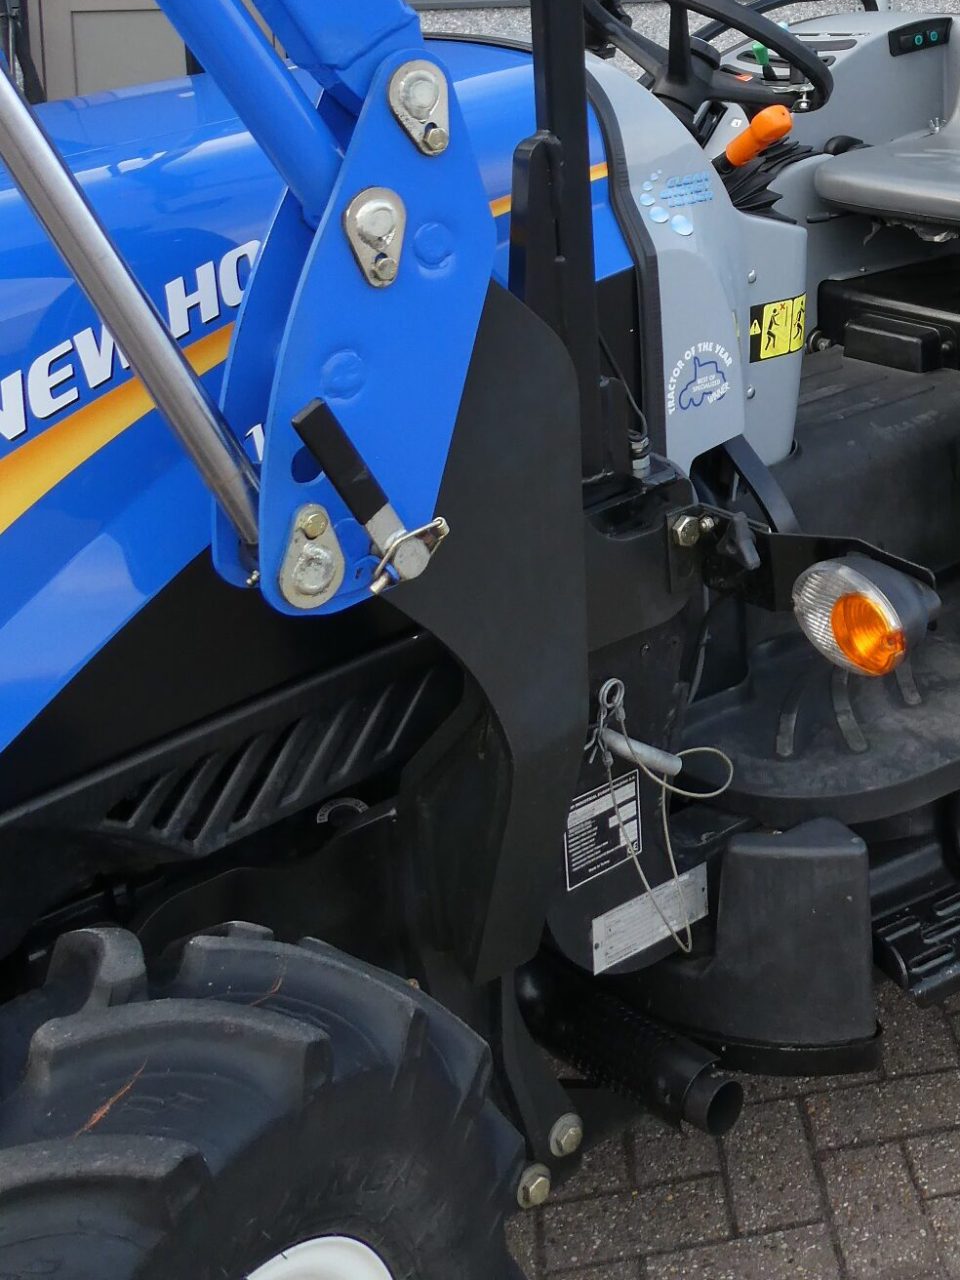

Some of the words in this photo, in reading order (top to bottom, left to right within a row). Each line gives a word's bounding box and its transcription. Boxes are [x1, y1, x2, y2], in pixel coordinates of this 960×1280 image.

[667, 360, 684, 415] TRACTOR
[684, 346, 696, 360] OF
[697, 341, 714, 352] THE
[715, 343, 733, 367] YEAR
